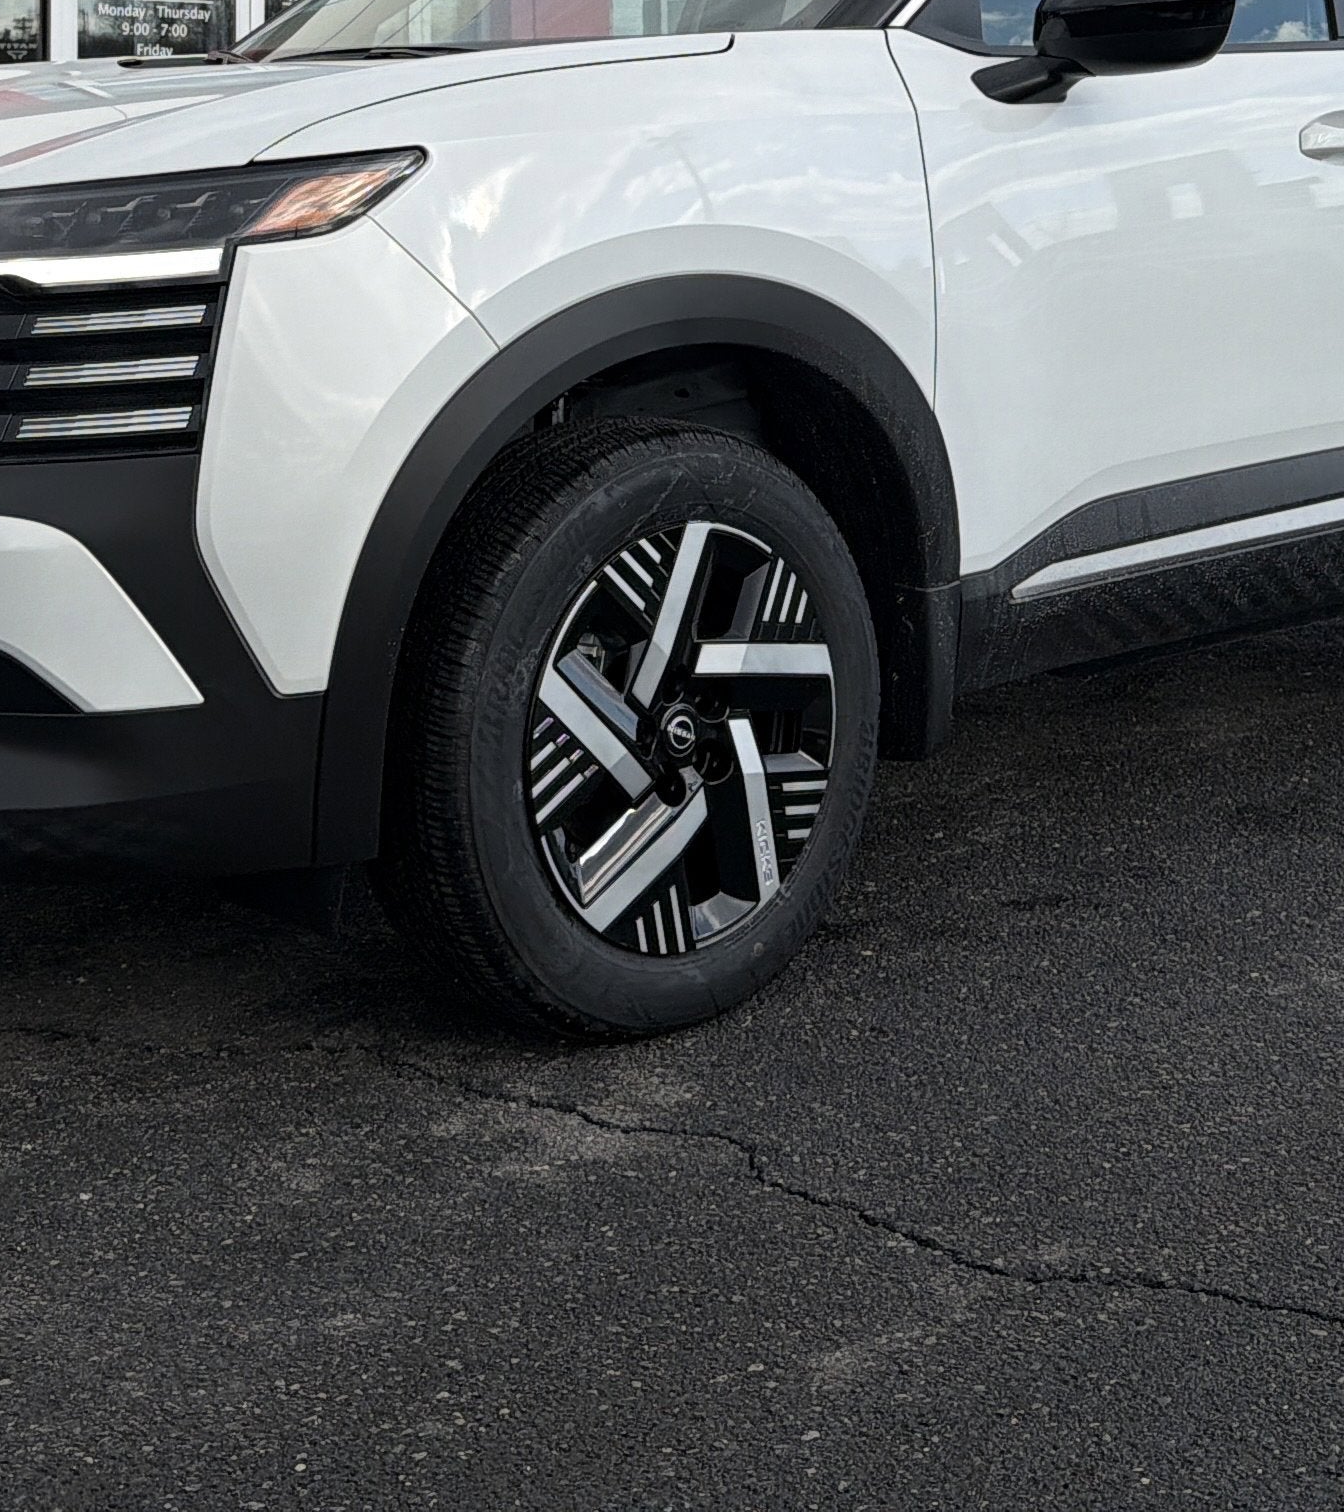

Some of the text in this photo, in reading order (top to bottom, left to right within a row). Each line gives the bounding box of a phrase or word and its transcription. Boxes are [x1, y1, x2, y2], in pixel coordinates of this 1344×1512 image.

[98, 2, 147, 20] Monday
[156, 5, 212, 22] Thursday
[121, 22, 150, 36] 9:00
[160, 23, 189, 38] 7:00
[136, 43, 174, 57] Friday
